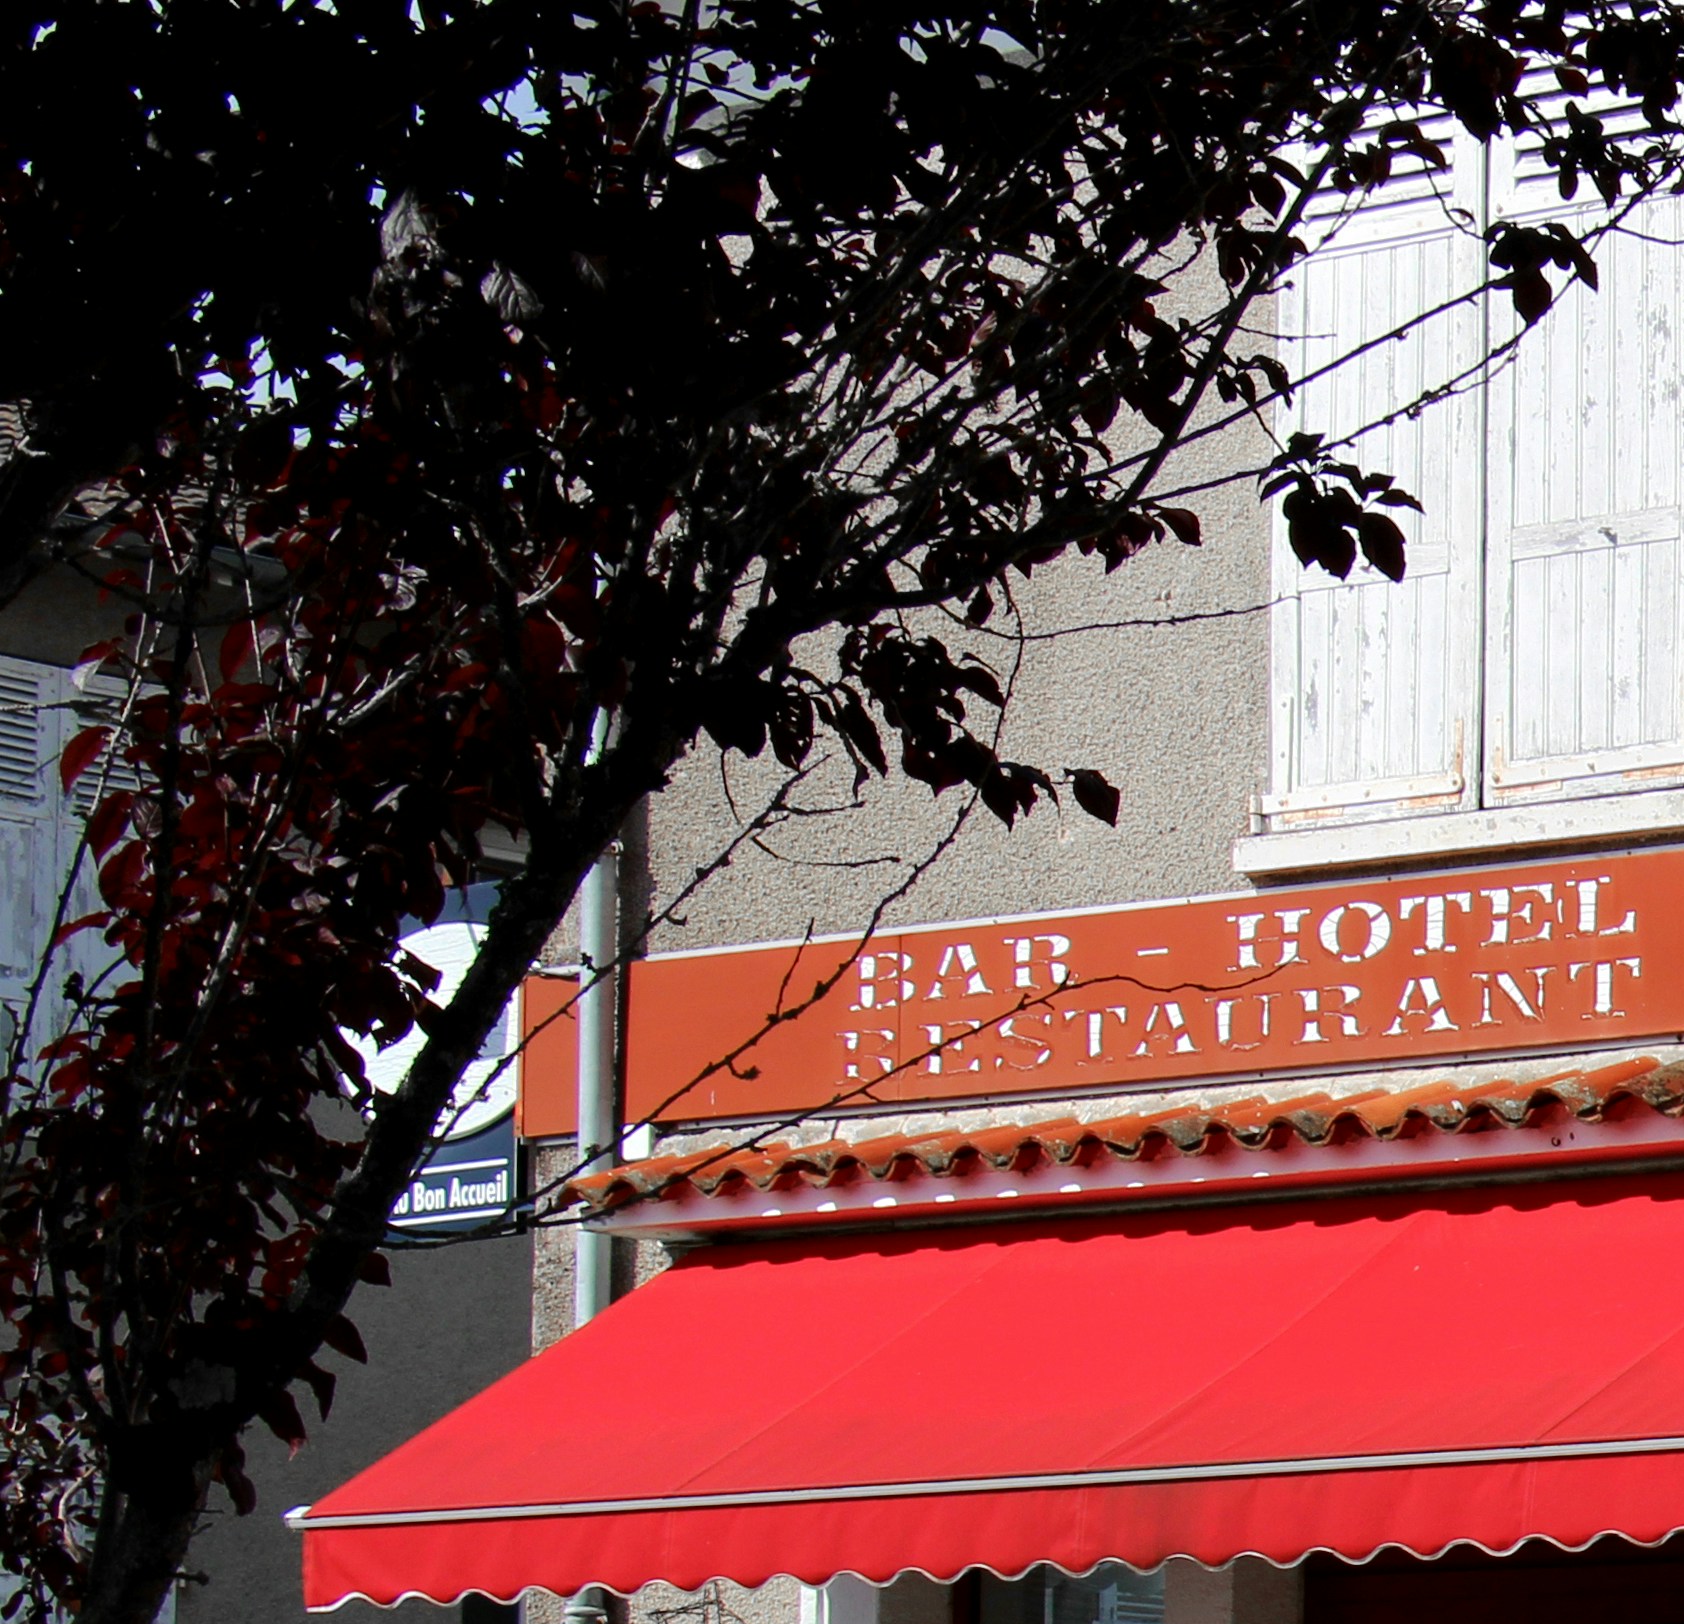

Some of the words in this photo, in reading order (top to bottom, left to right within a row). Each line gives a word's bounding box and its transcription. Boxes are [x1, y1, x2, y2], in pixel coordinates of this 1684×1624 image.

[850, 932, 1079, 1014] BAR
[1226, 873, 1639, 973] HOTEL
[839, 957, 1642, 1085] RESTAURANT
[413, 1182, 446, 1213] Bon
[449, 1170, 509, 1208] Accueil
